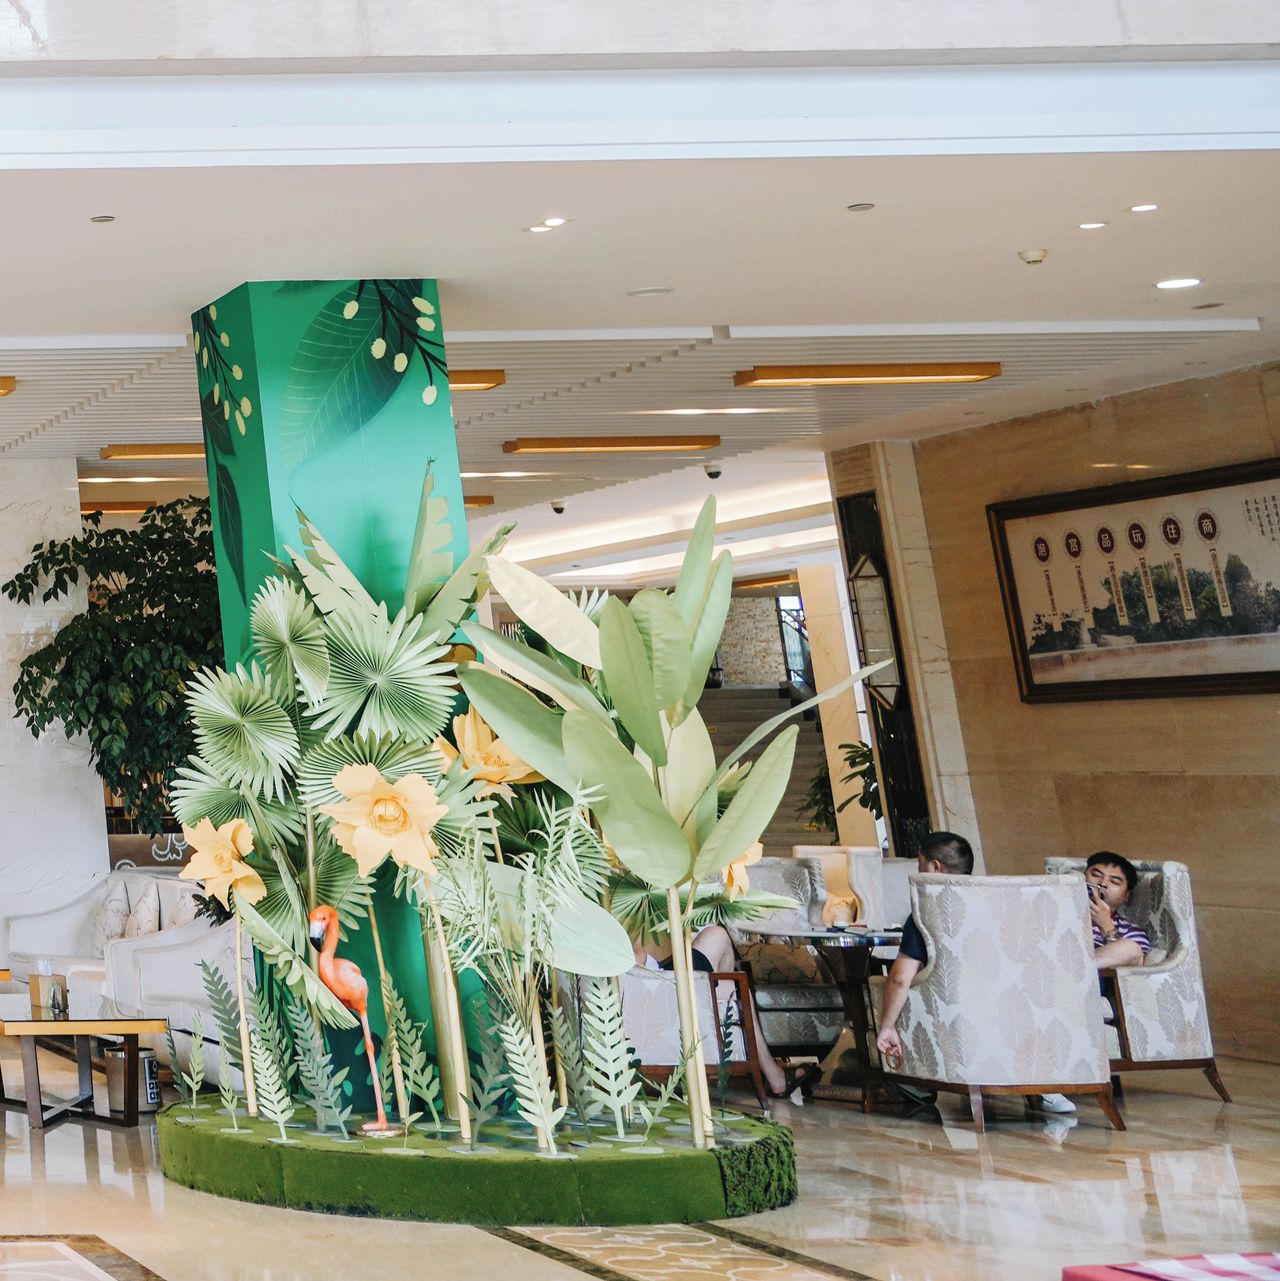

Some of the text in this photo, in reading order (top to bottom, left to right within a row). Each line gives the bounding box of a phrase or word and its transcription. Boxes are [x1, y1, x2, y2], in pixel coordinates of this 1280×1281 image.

[1101, 534, 1111, 547] 品
[1132, 530, 1143, 543] 玩
[1166, 524, 1176, 538] 住
[1201, 519, 1213, 534] 商
